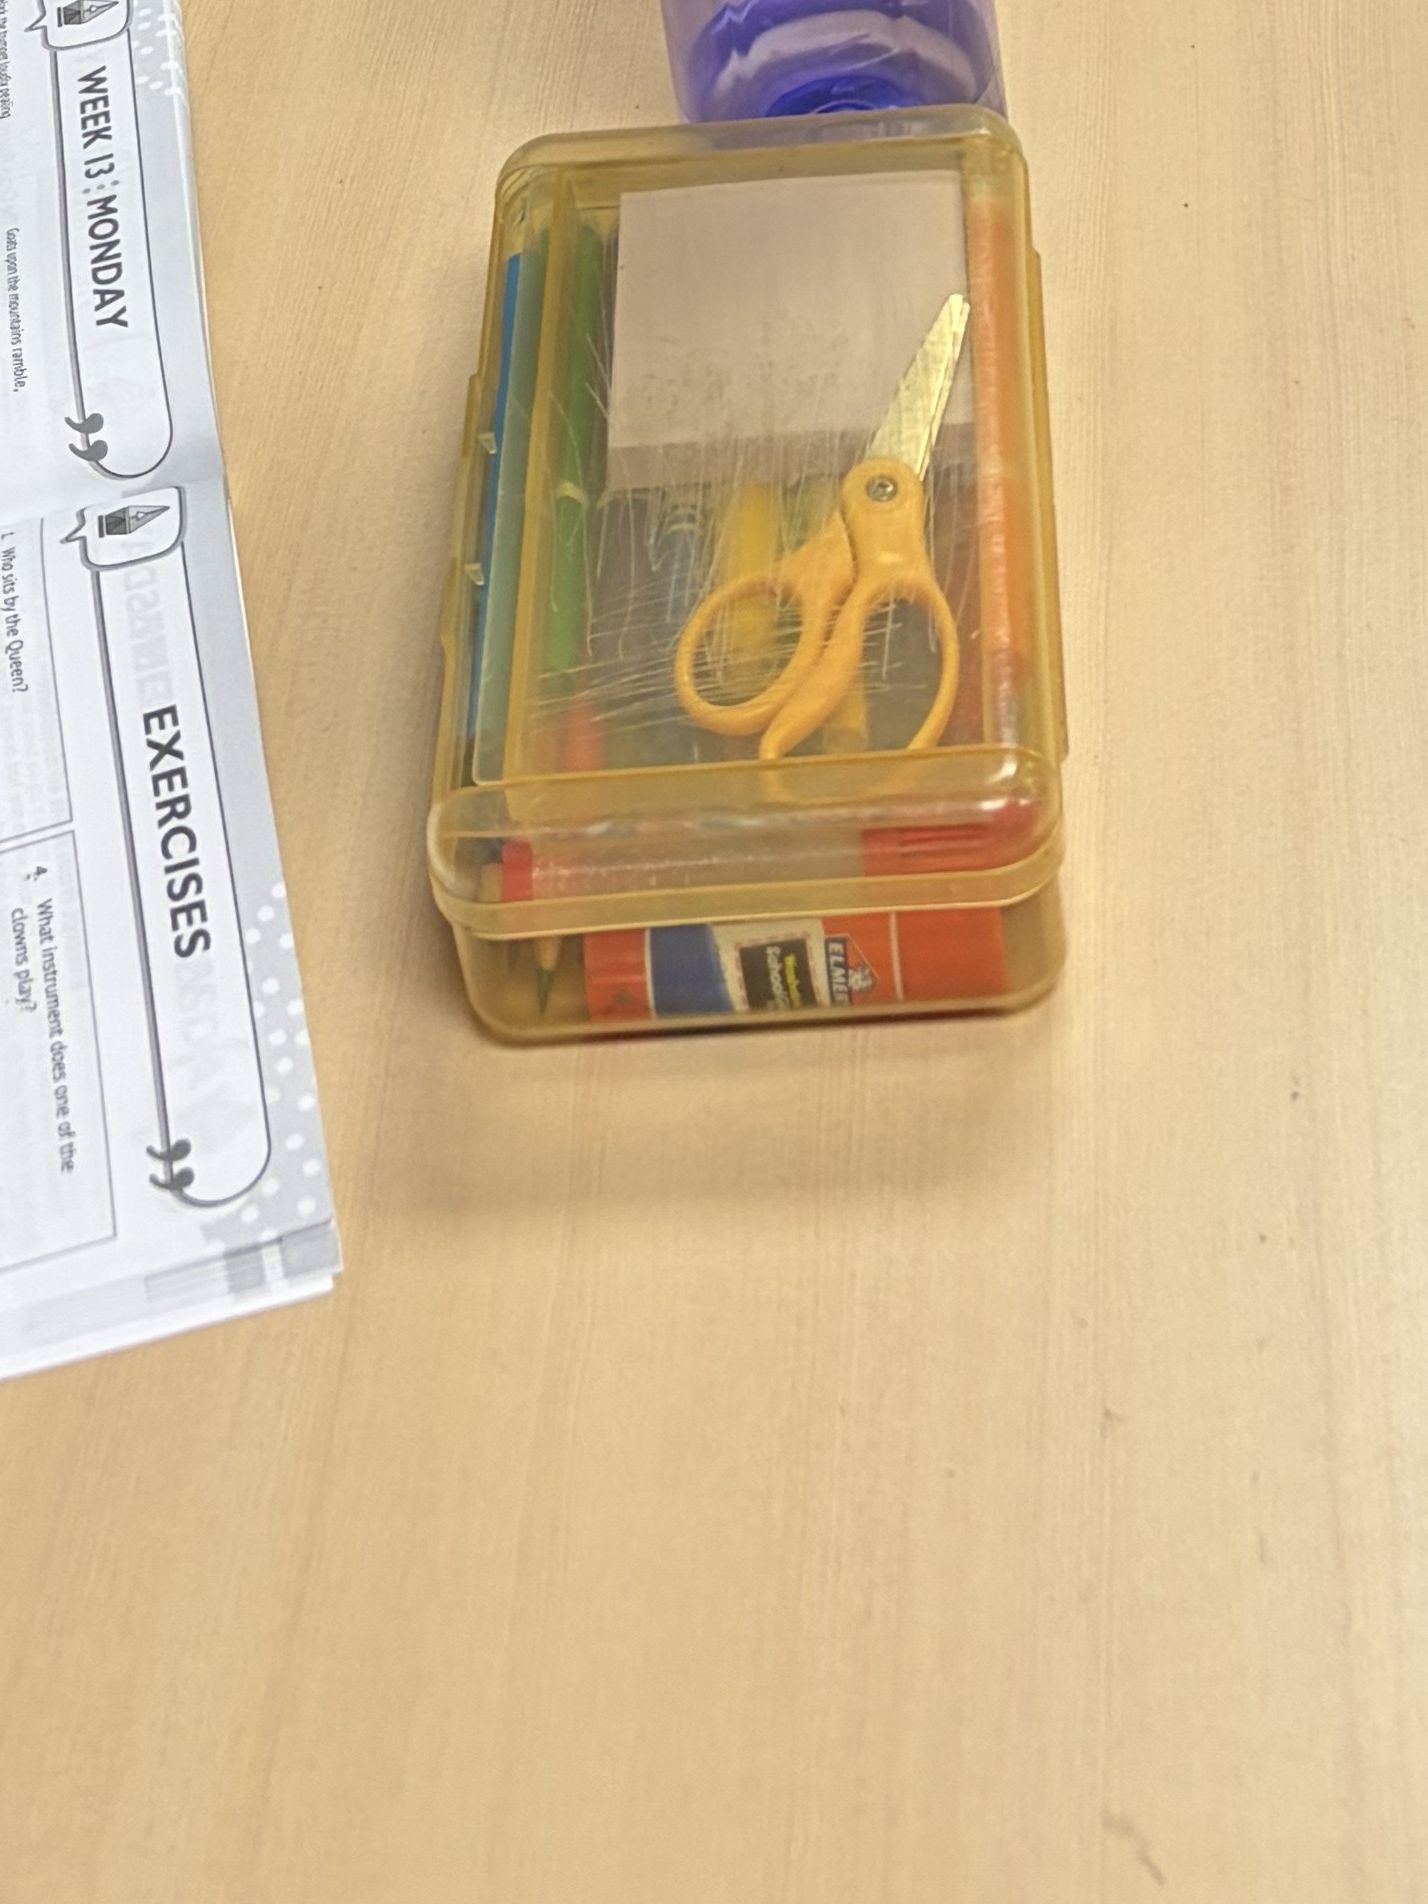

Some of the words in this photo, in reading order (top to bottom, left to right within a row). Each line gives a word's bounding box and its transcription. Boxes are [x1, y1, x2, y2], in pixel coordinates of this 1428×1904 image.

[76, 65, 112, 149] WEEK
[83, 152, 115, 179] 13
[86, 193, 128, 327] MONDAY
[0, 546, 16, 571] Who
[0, 572, 17, 594] sits
[4, 612, 21, 637] the
[4, 638, 29, 692] Queen?
[142, 703, 211, 958] EXERCISES
[10, 907, 29, 966] clowns
[36, 897, 54, 945] What
[12, 968, 35, 1012] play?
[41, 944, 64, 1039] instrument
[49, 1040, 67, 1083] does
[53, 1084, 70, 1119] one
[58, 1141, 76, 1172] the
